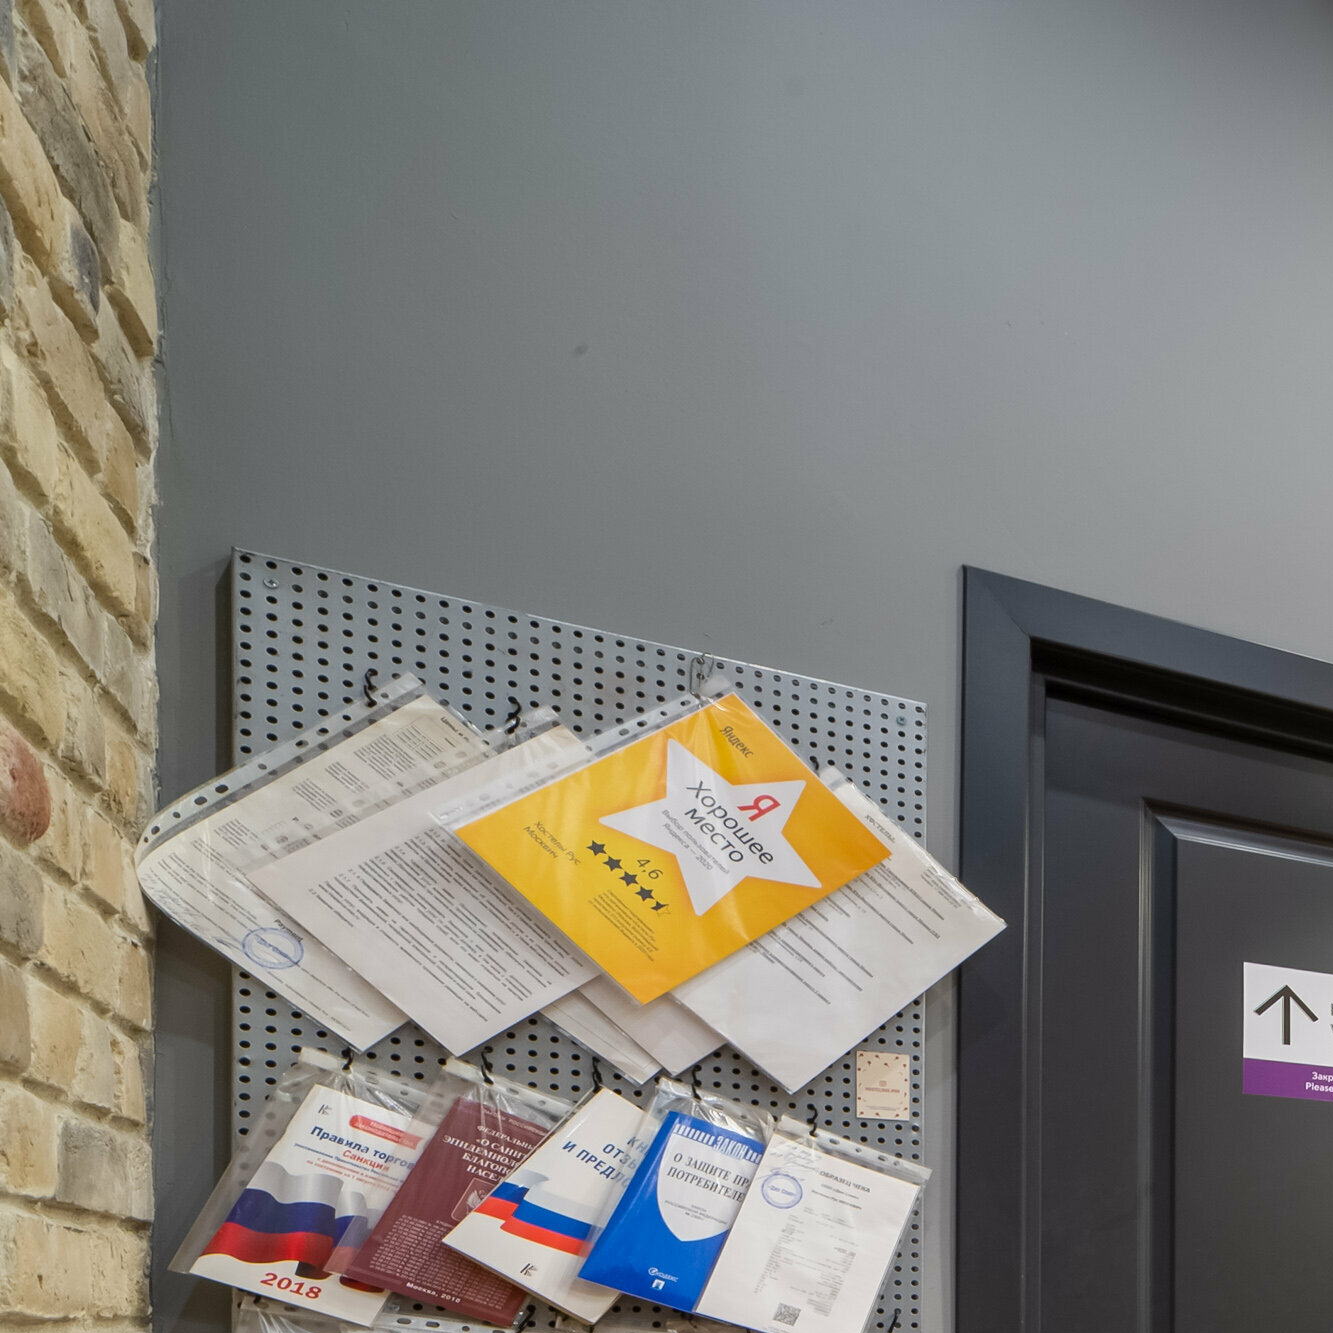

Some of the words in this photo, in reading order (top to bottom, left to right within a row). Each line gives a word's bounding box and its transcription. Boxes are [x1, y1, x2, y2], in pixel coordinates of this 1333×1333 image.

[720, 726, 753, 758] Яндекс
[737, 794, 781, 822] Я
[685, 808, 744, 863] место
[686, 781, 774, 865] Хорошее
[524, 826, 558, 859] Москвич
[534, 821, 566, 852] Хостелы
[566, 851, 581, 866] Рус
[663, 823, 690, 849] Яндекса
[695, 854, 714, 871] 2020
[637, 859, 664, 880] 4,6
[1305, 1082, 1333, 1092] Please
[311, 1125, 370, 1154] Правила
[562, 1141, 577, 1153] И
[714, 1136, 749, 1160] ЗАКОН
[342, 1149, 390, 1172] Санкции
[673, 1152, 683, 1163] О
[685, 1156, 732, 1181] ЗАЩИТЕ
[820, 1170, 851, 1188] ОБРАЗЕЦ
[853, 1182, 871, 1193] ЧЕКА
[260, 1272, 322, 1300] 2018
[406, 1281, 439, 1297] Москва,
[440, 1293, 461, 1303] 2018
